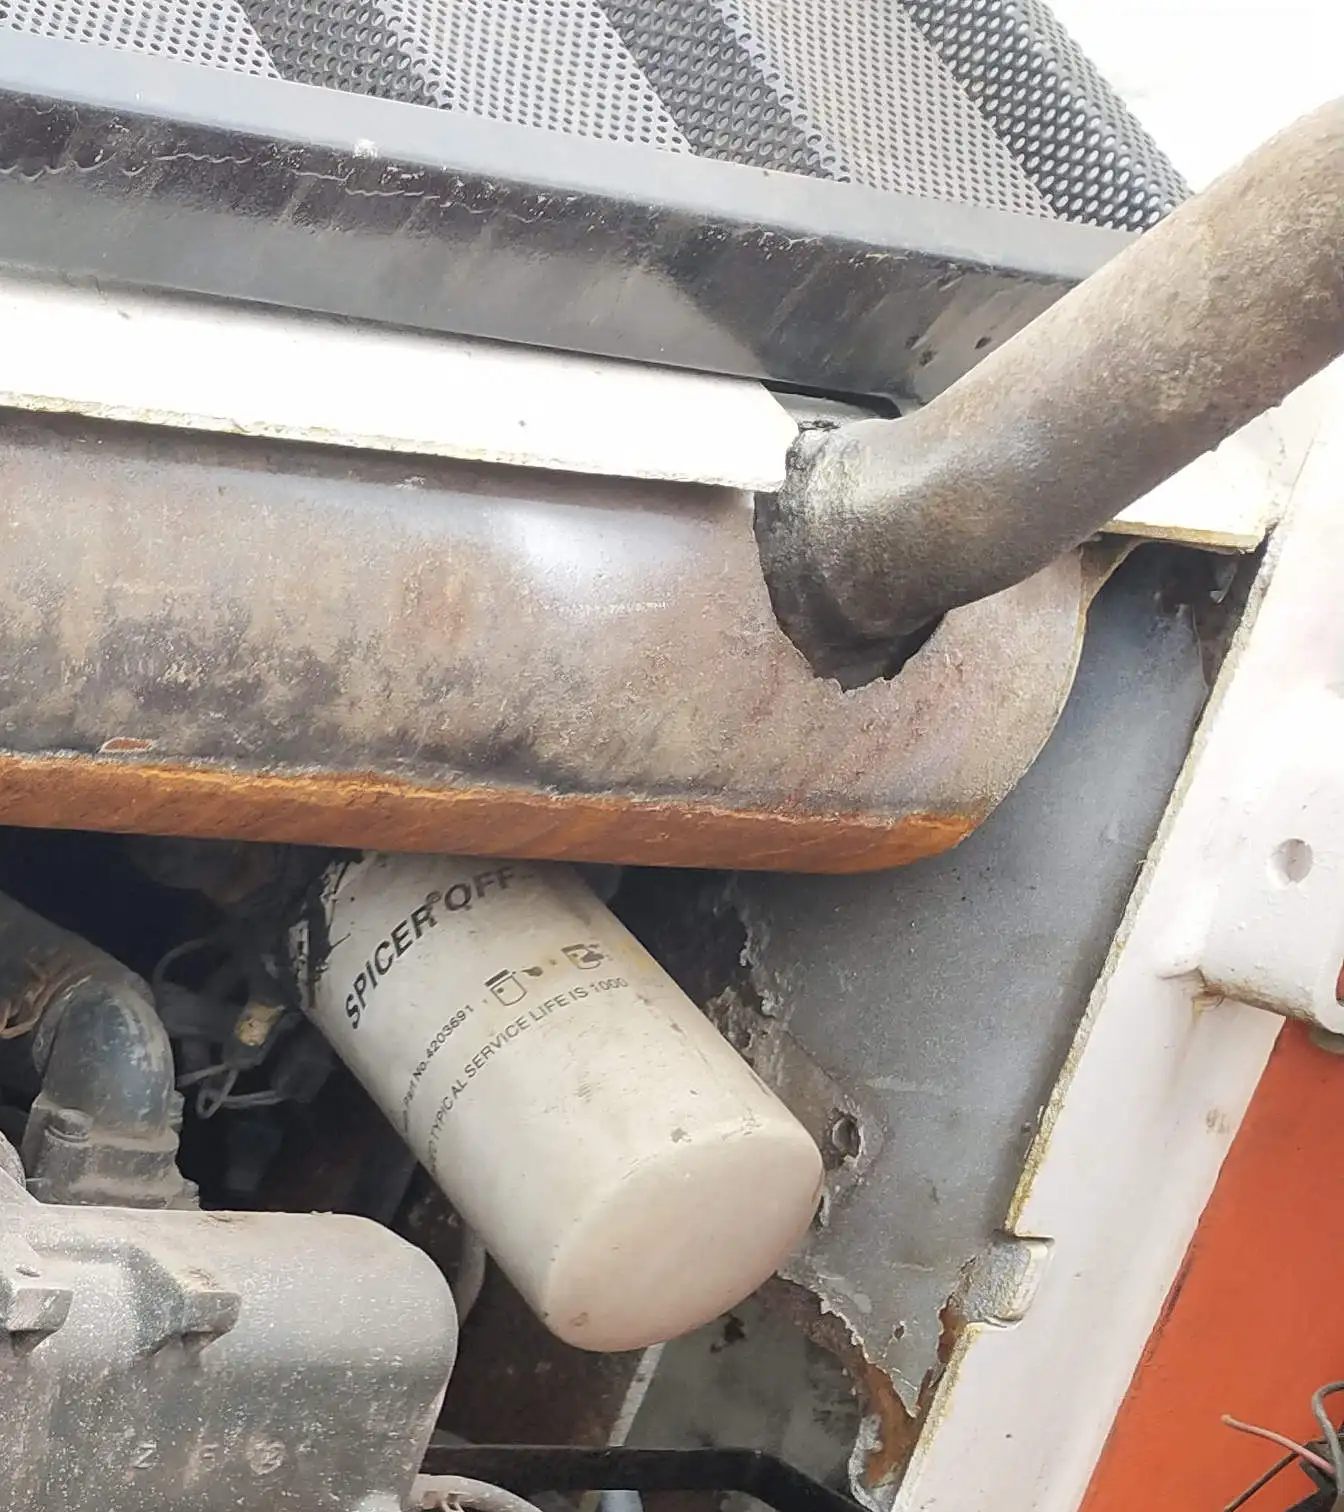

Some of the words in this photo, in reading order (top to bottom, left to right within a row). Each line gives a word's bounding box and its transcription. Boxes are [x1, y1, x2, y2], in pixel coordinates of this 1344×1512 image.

[464, 1016, 531, 1078] SERVICE
[528, 993, 571, 1020] LIFE
[568, 986, 589, 1000] IS
